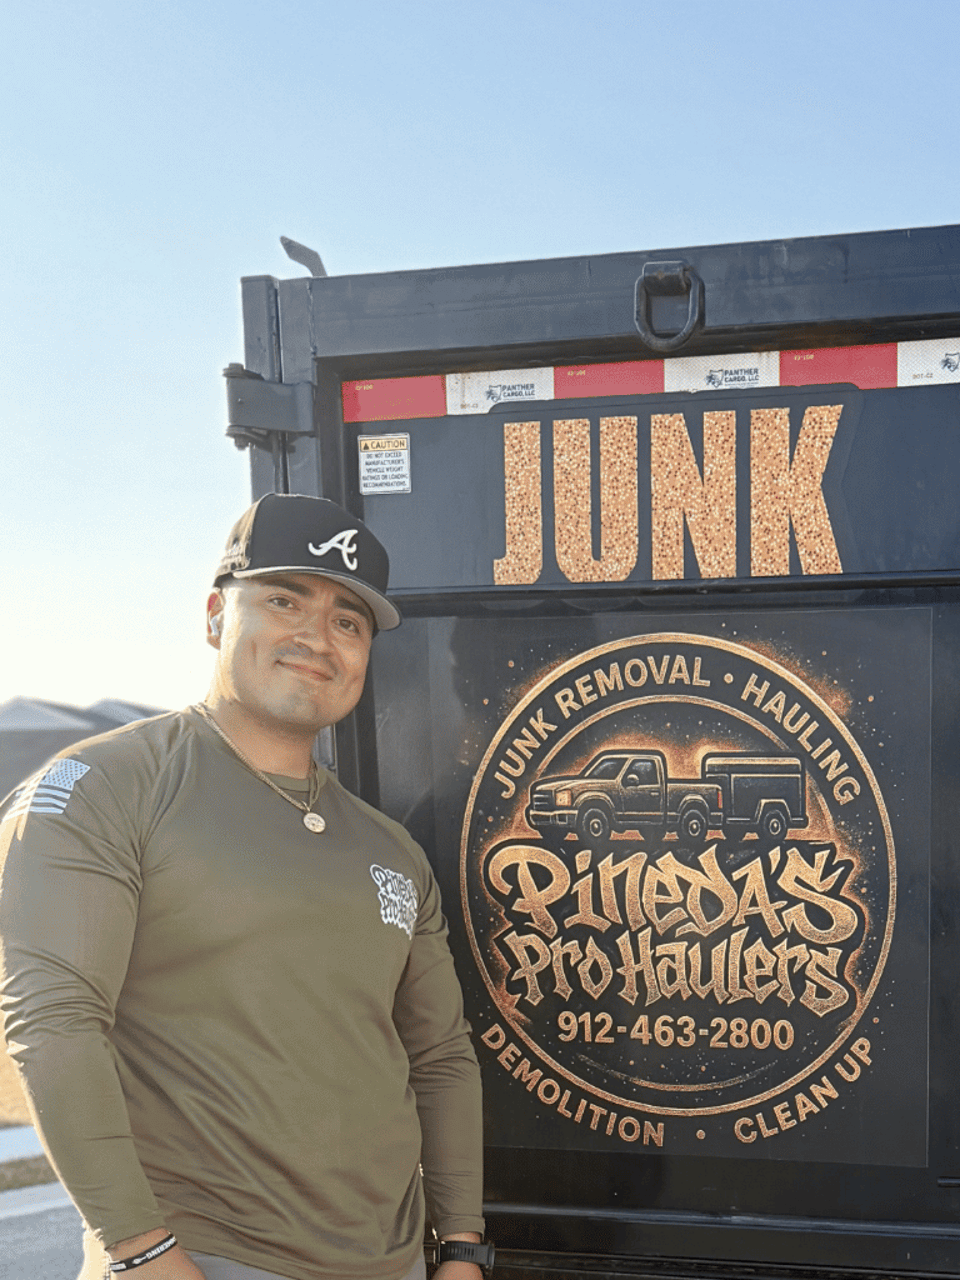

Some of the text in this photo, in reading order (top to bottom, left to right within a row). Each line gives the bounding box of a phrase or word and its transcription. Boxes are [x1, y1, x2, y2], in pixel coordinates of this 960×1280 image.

[371, 440, 405, 449] CAUTION
[493, 404, 843, 585] JUNK
[308, 529, 358, 571] A
[494, 655, 861, 806] JUNK REMOVAL HAULING
[503, 927, 849, 1016] Pro Haulers
[558, 1011, 795, 1051] 912-463-2800
[481, 1023, 873, 1147] DEMOLITION CLEAN UP
